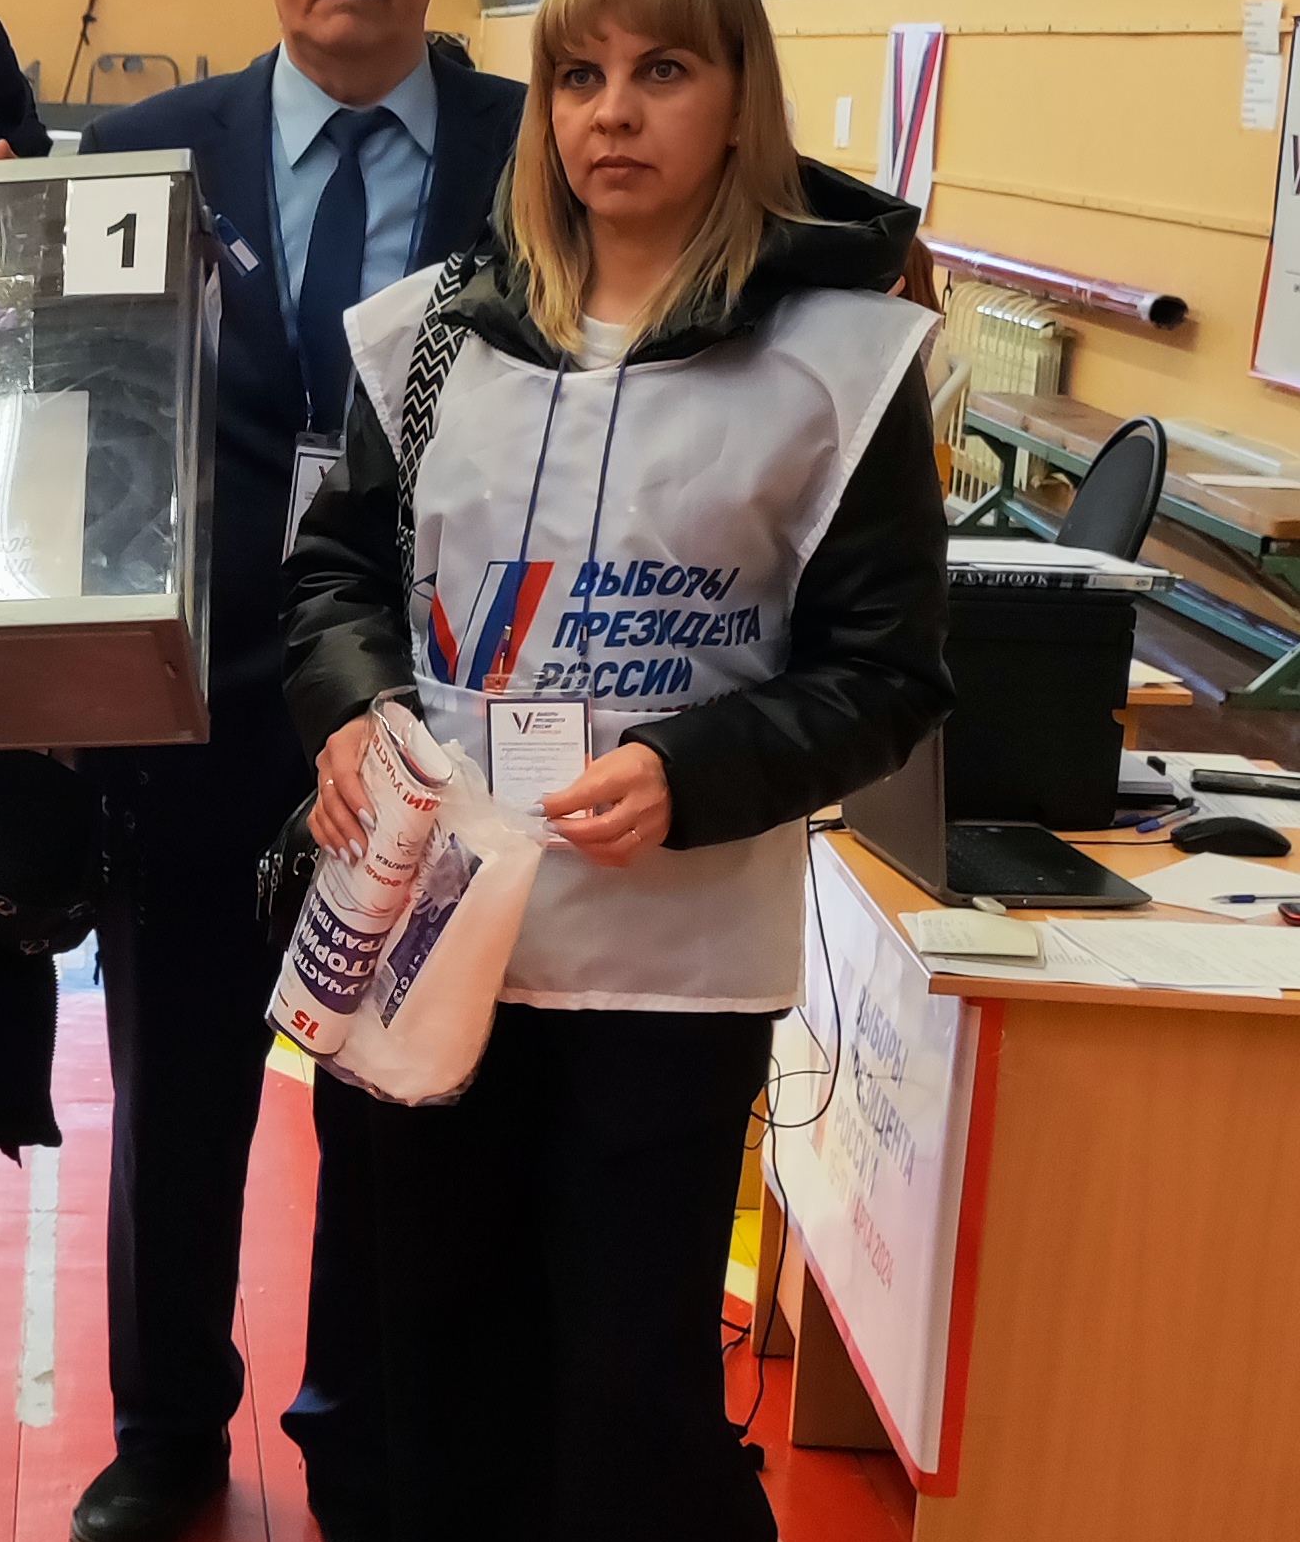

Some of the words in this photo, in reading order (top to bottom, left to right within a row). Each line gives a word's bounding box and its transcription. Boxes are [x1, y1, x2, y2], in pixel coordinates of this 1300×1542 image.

[107, 213, 138, 268] 1
[570, 560, 740, 601] ВЫБОРЫ
[948, 572, 986, 583] LAY
[996, 573, 1048, 585] BOOK
[534, 657, 693, 699] РОССИИ
[402, 792, 441, 812] ДИ!
[300, 923, 377, 977] ТОРИН
[291, 1009, 320, 1040] 15
